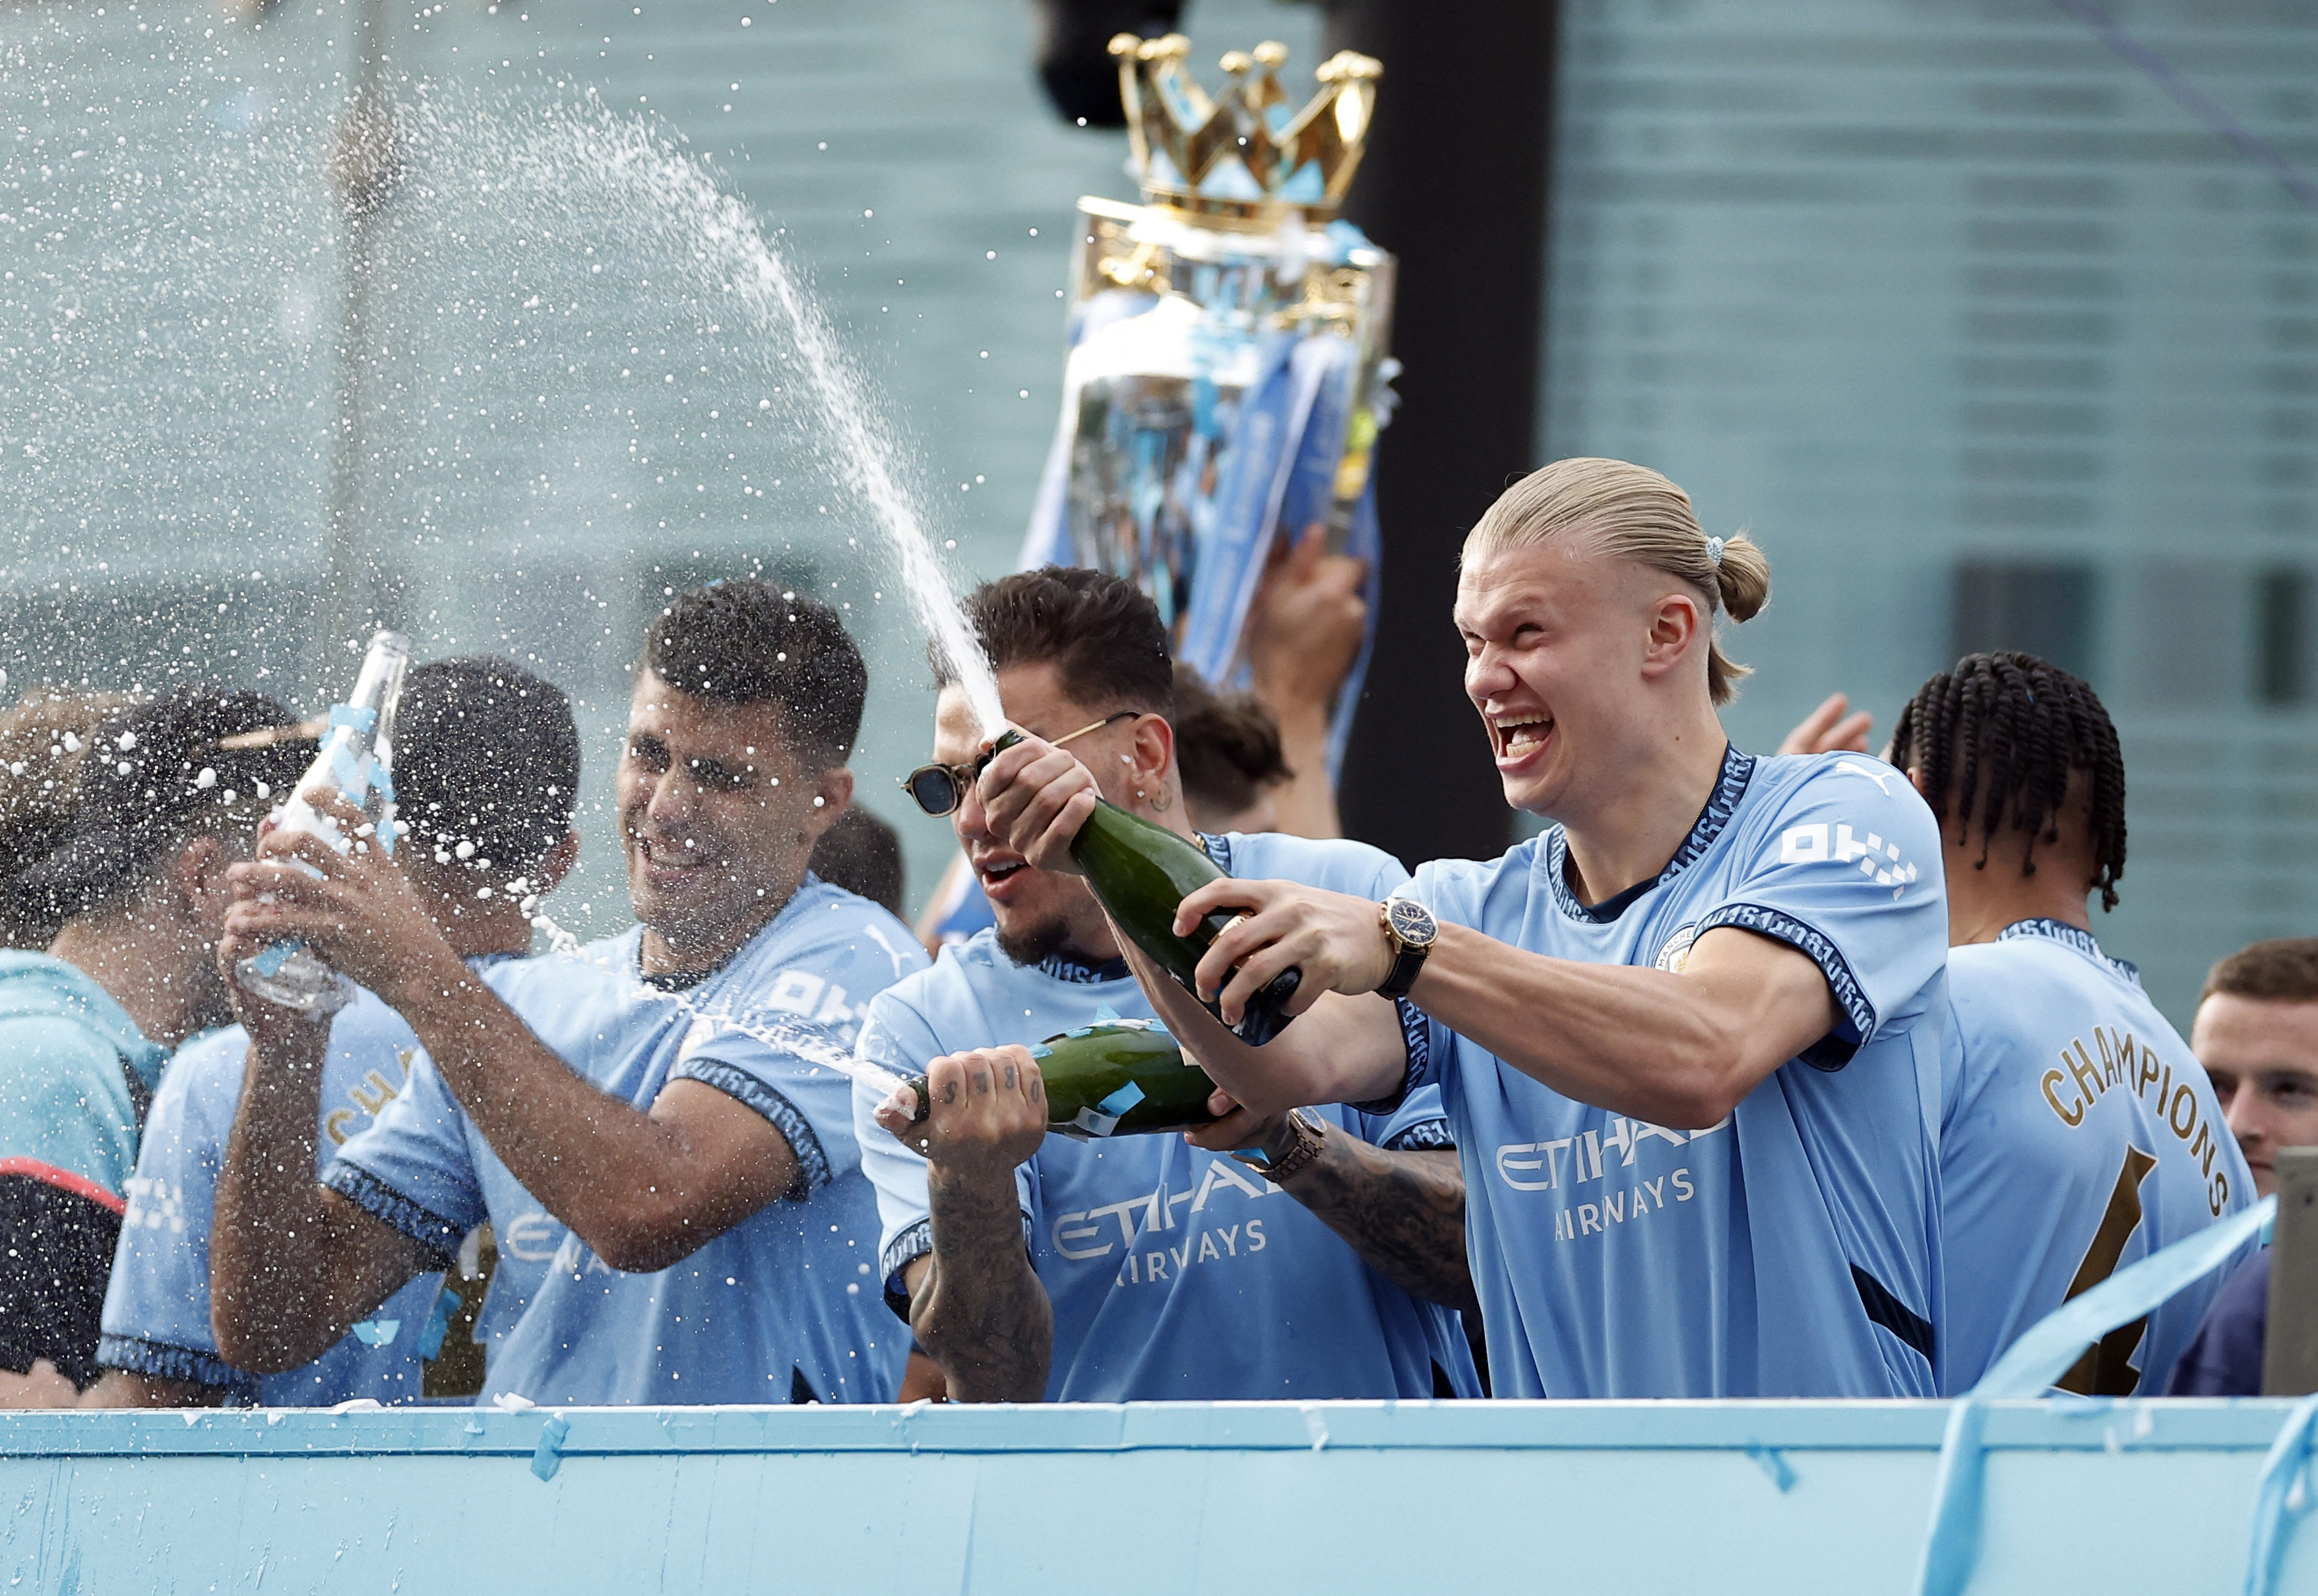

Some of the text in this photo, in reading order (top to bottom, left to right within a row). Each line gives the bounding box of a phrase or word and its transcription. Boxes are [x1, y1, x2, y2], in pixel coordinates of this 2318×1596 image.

[1496, 1117, 1731, 1191] ETIHA
[2040, 1024, 2230, 1218] CHAMPIONS
[1052, 1159, 1283, 1260] ETIHA
[1555, 1168, 1694, 1241] AIRWAYS
